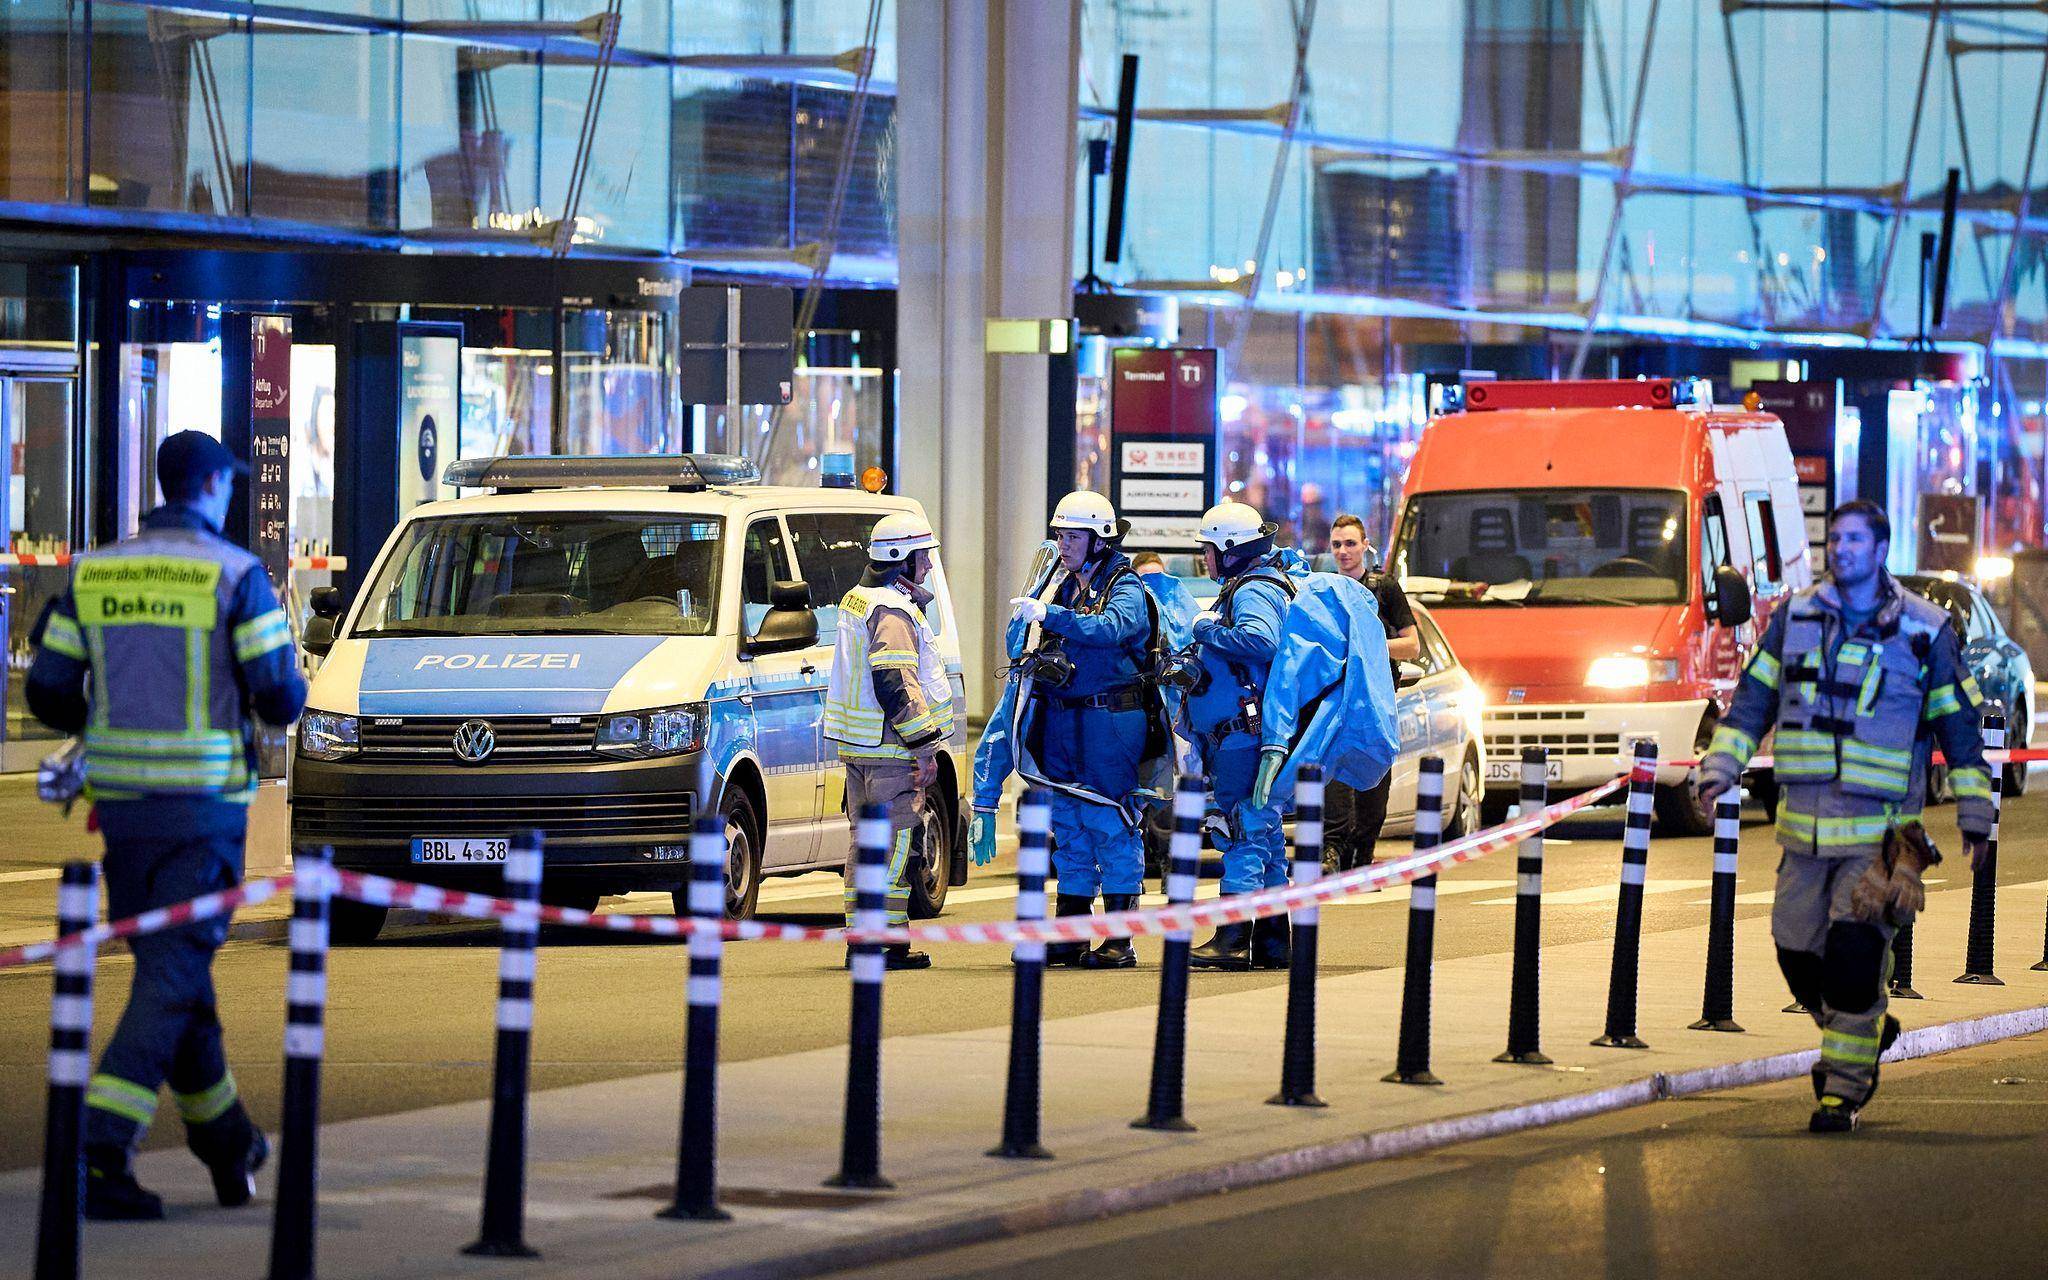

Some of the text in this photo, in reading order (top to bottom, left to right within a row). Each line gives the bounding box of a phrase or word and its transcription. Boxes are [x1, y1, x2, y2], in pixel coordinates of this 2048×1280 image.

[1124, 365, 1200, 383] Terminal T1
[413, 653, 581, 671] POLIZEI
[423, 841, 456, 861] BBL
[462, 841, 473, 861] 4
[486, 841, 507, 861] 38
